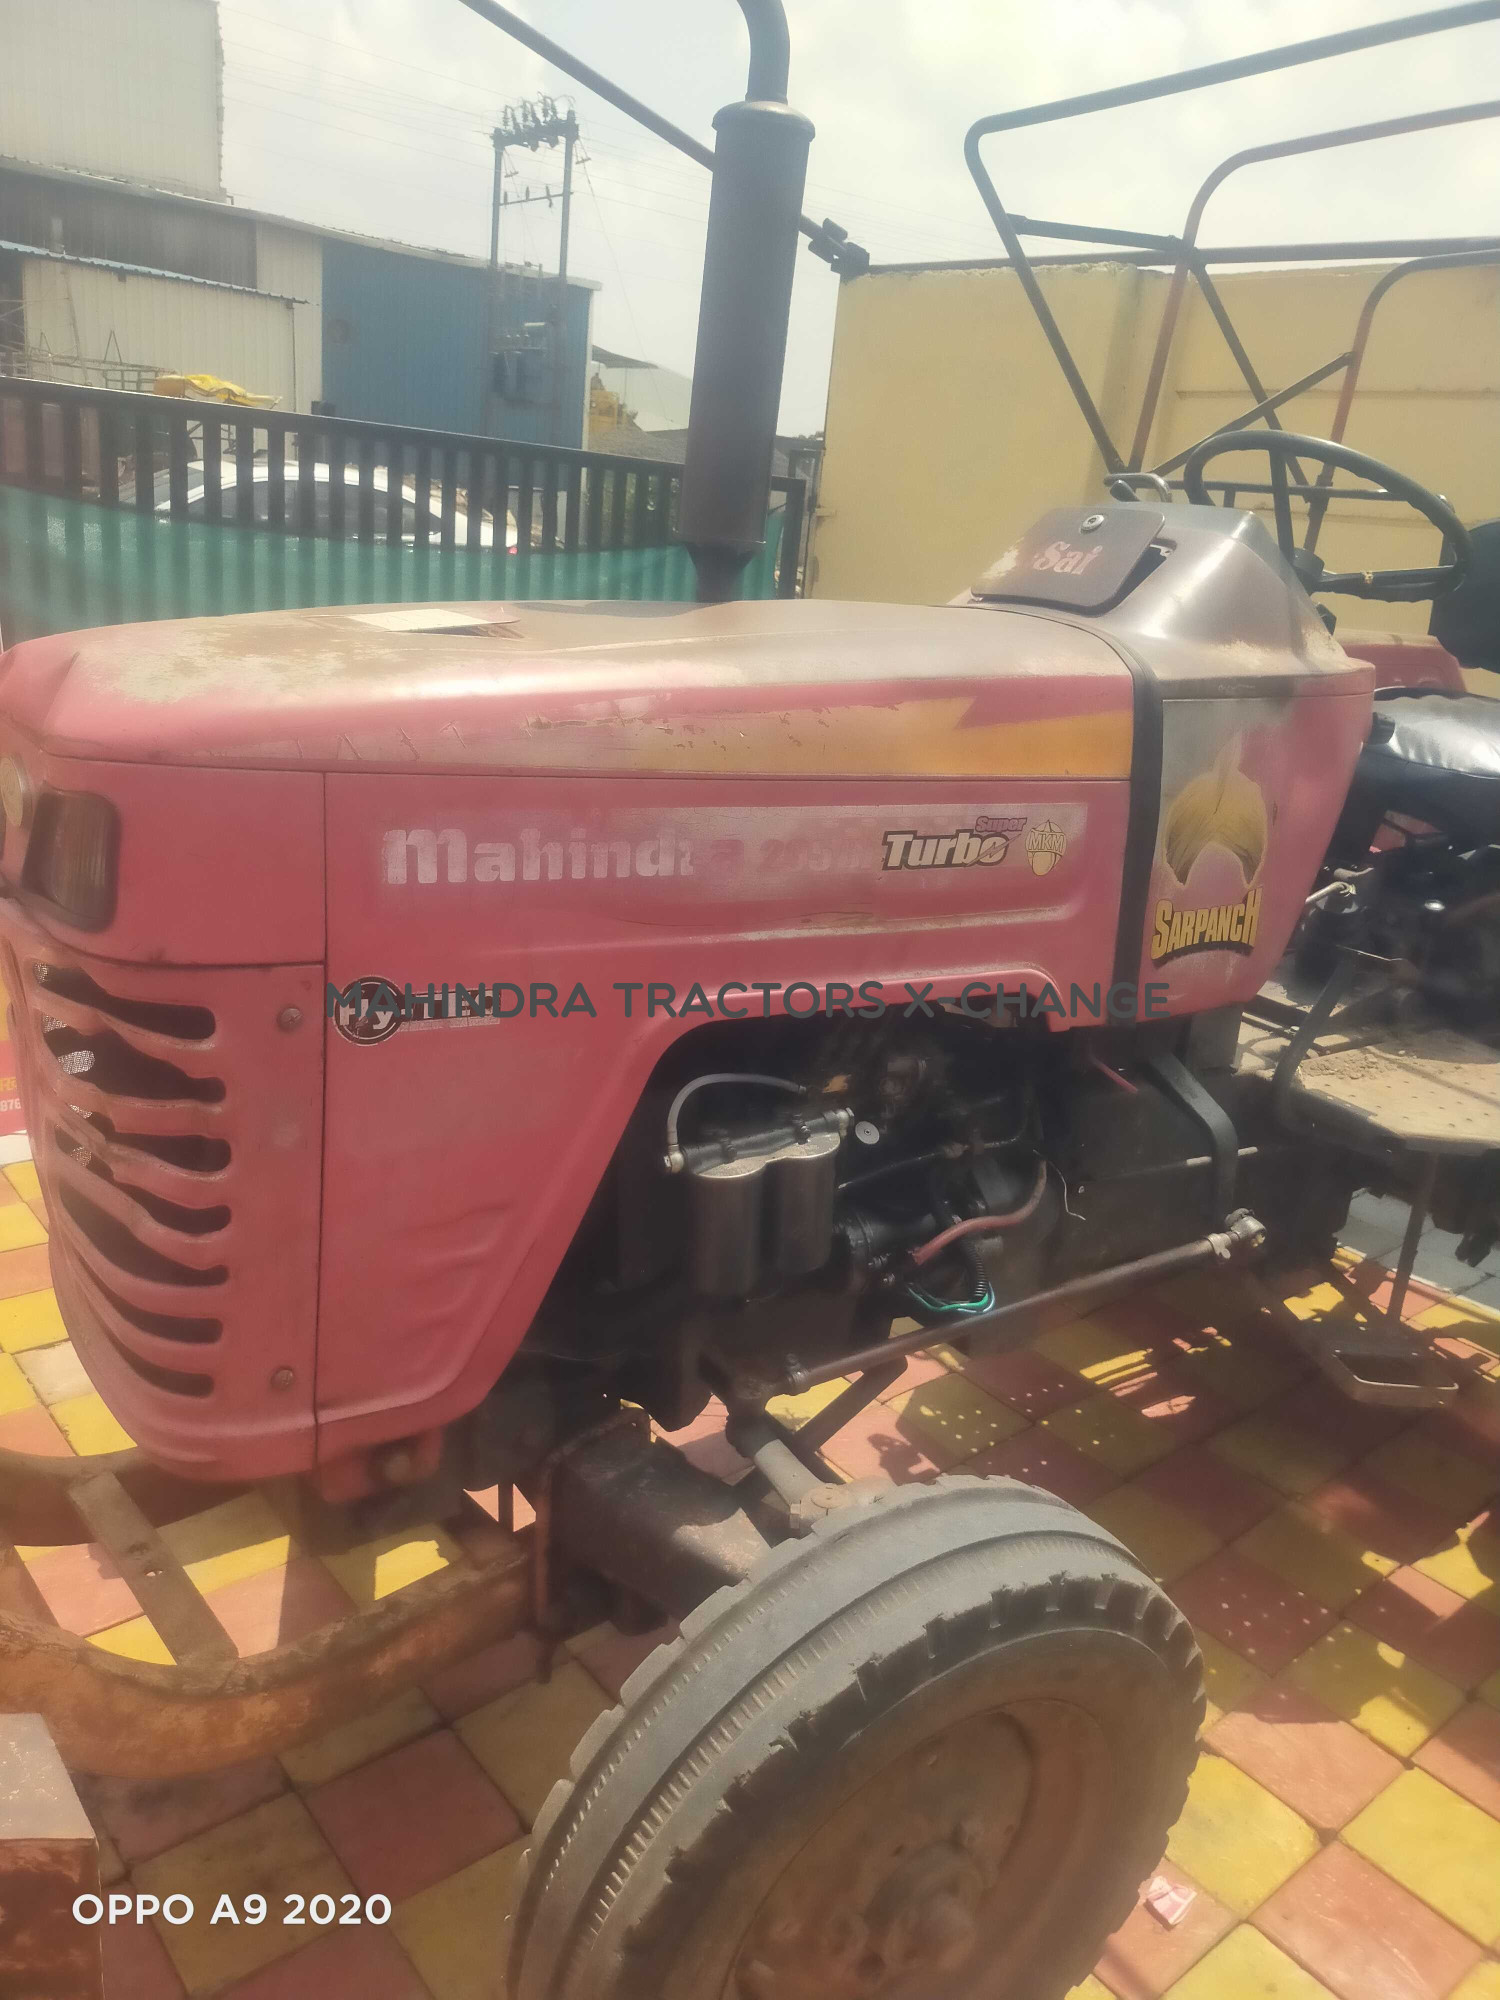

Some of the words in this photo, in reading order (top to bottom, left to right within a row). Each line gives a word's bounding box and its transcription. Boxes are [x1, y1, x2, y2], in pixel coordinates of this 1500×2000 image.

[975, 816, 1028, 832] Super
[882, 829, 1010, 870] Turbo
[1029, 833, 1065, 852] MKM
[1151, 887, 1263, 960] SARPANCH
